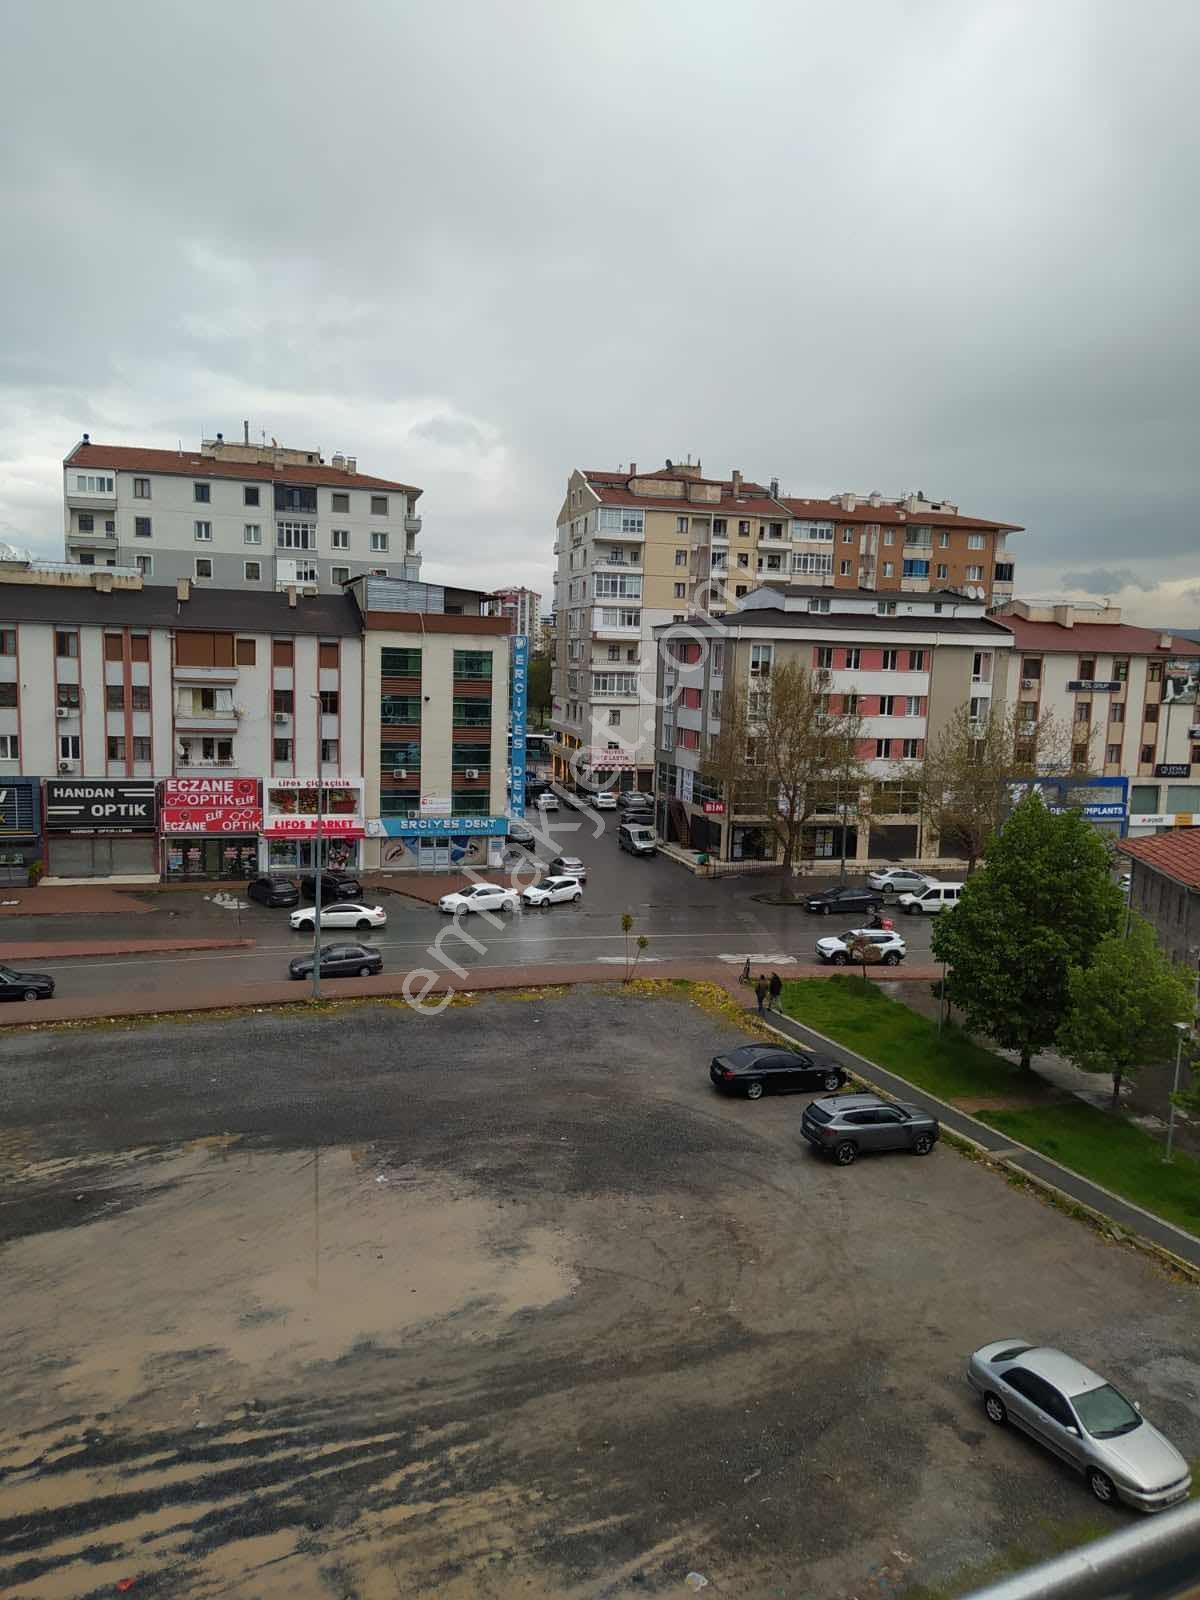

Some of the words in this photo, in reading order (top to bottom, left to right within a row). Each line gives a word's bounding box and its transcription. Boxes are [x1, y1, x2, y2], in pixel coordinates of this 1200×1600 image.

[167, 780, 234, 792] ECZANE
[53, 788, 115, 798] HANDAN
[512, 766, 524, 817] DENT
[164, 822, 207, 831] ECZANE
[465, 819, 497, 828] DENT
